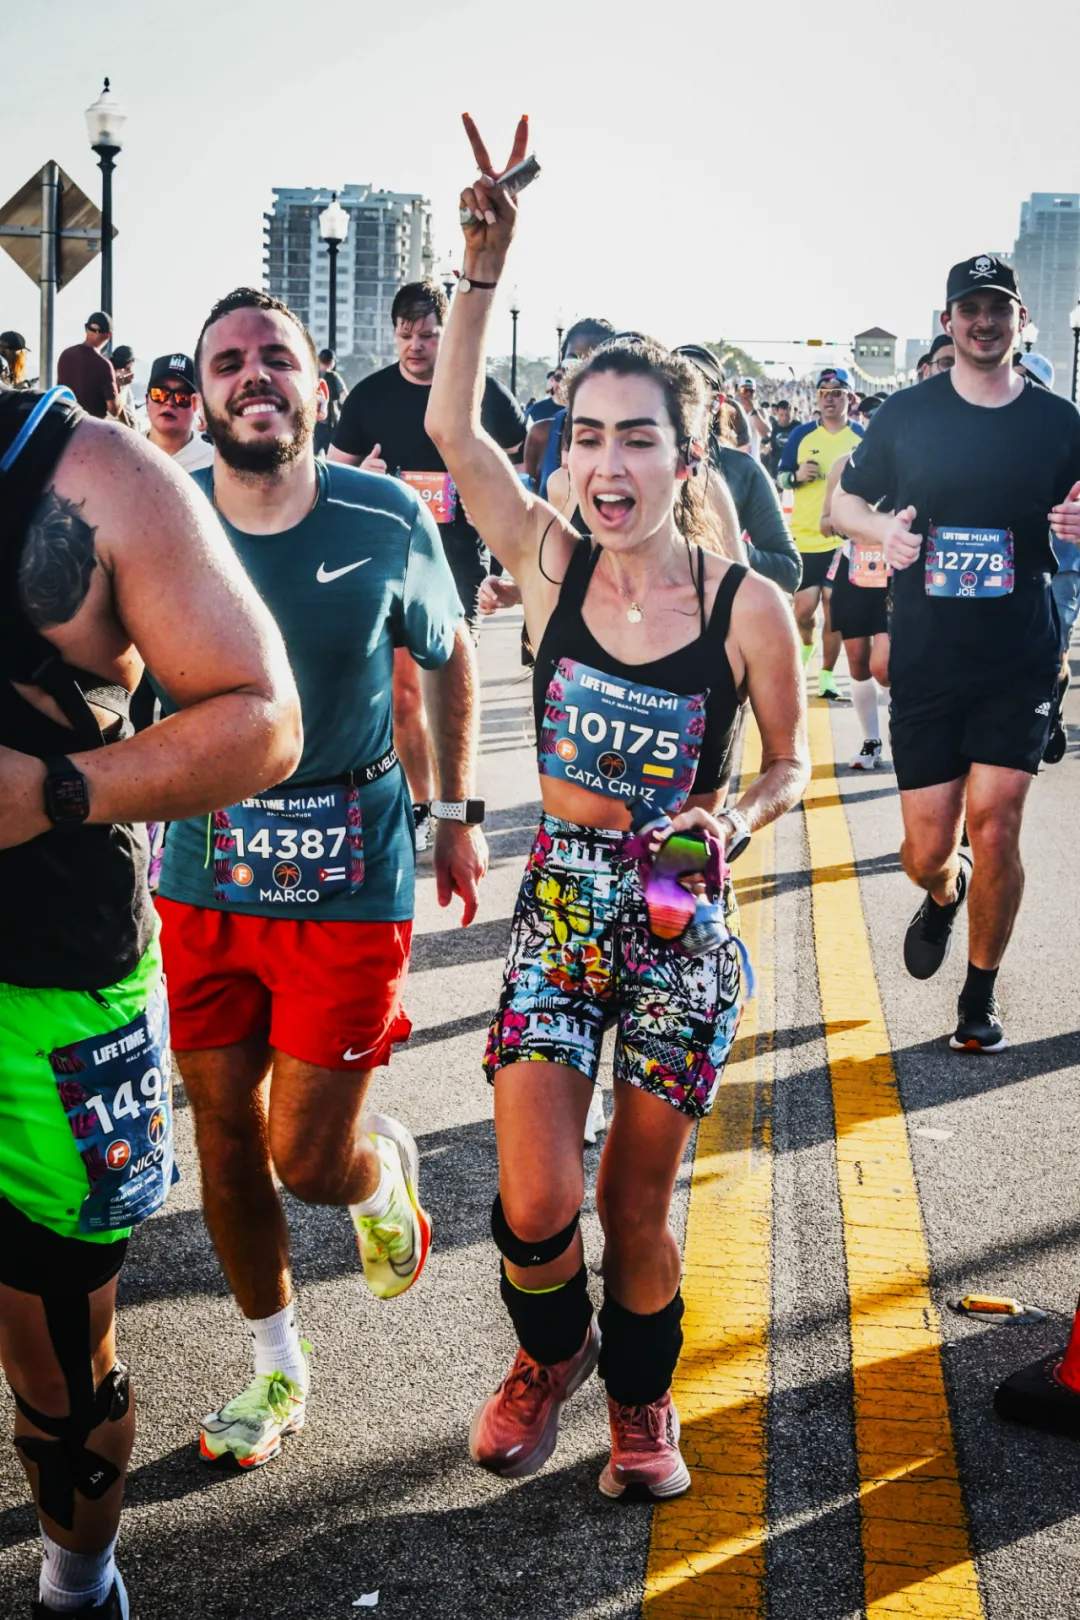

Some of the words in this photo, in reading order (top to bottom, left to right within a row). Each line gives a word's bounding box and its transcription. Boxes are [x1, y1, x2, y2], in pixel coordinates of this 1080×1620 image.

[421, 489, 444, 502] 94
[971, 533, 1000, 542] MIAMI
[936, 551, 1004, 572] 12778
[956, 588, 976, 597] JOE
[628, 689, 679, 711] MIAMI
[564, 705, 680, 761] 10175
[565, 764, 604, 790] CATA
[608, 779, 657, 802] CRUZ
[288, 794, 336, 811] MIAMI
[230, 826, 347, 860] 14387
[259, 888, 320, 903] MARCO
[128, 1143, 165, 1179] NICO
